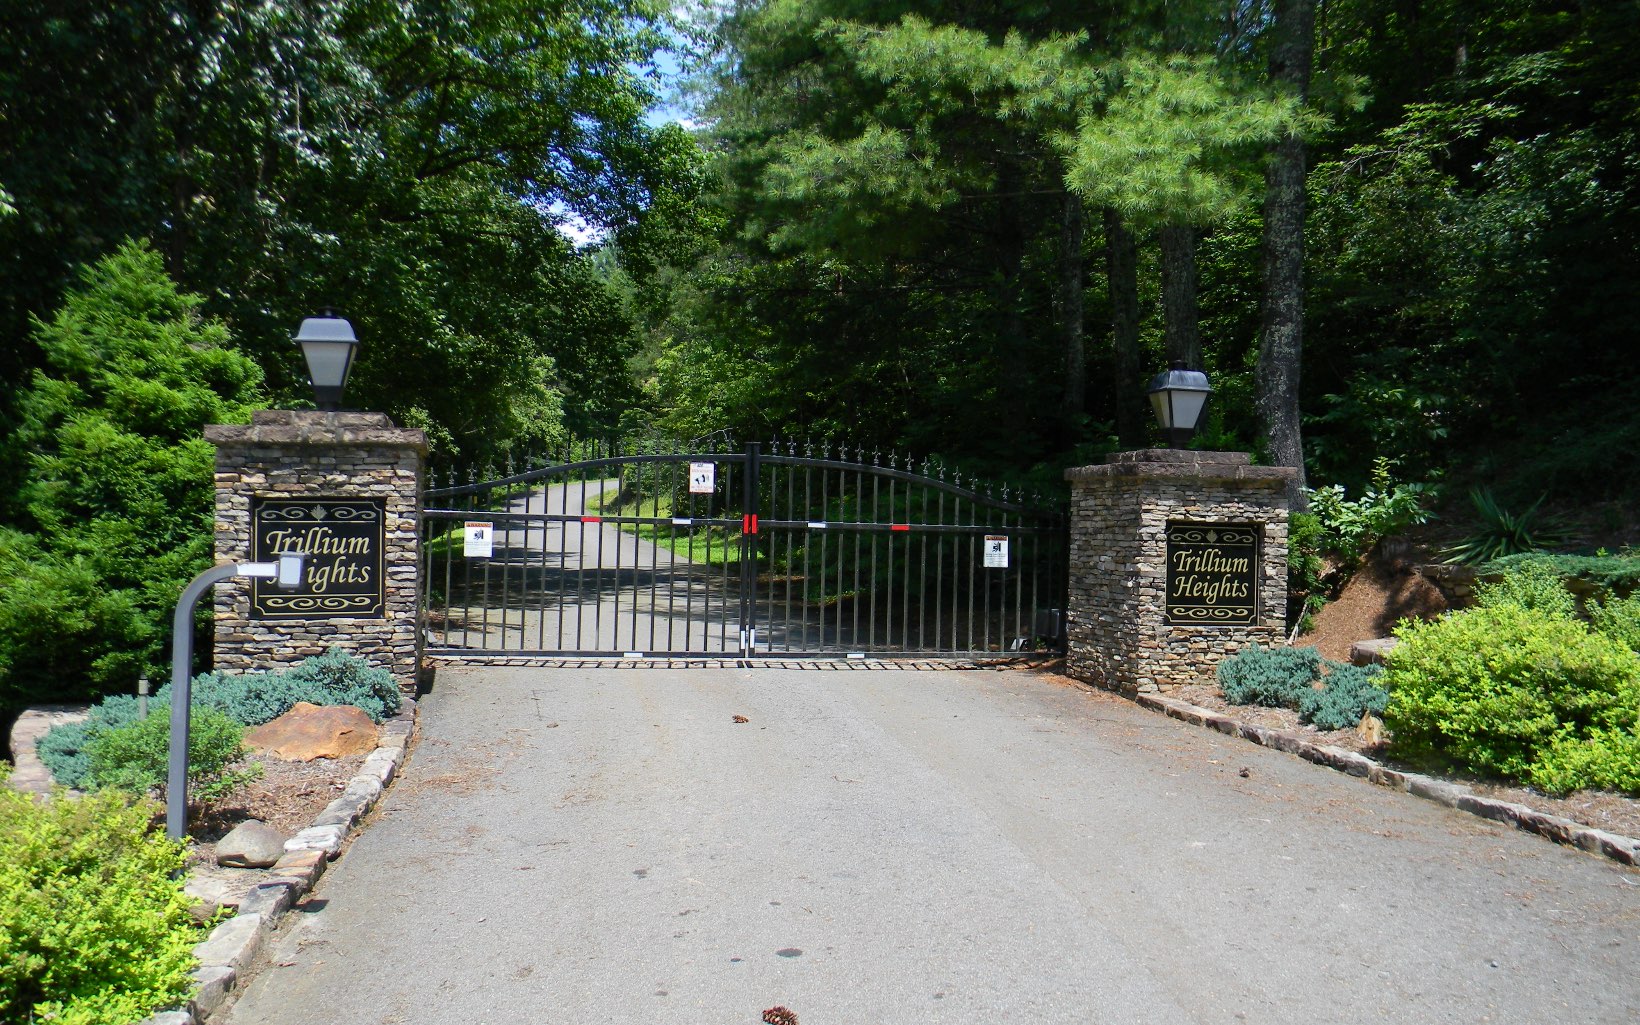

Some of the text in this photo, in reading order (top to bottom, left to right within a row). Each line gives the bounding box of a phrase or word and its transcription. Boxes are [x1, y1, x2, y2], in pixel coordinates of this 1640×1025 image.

[266, 527, 370, 554] Trillium
[266, 556, 371, 593] ights
[1173, 549, 1249, 573] Trillium
[1173, 574, 1249, 604] Heights
